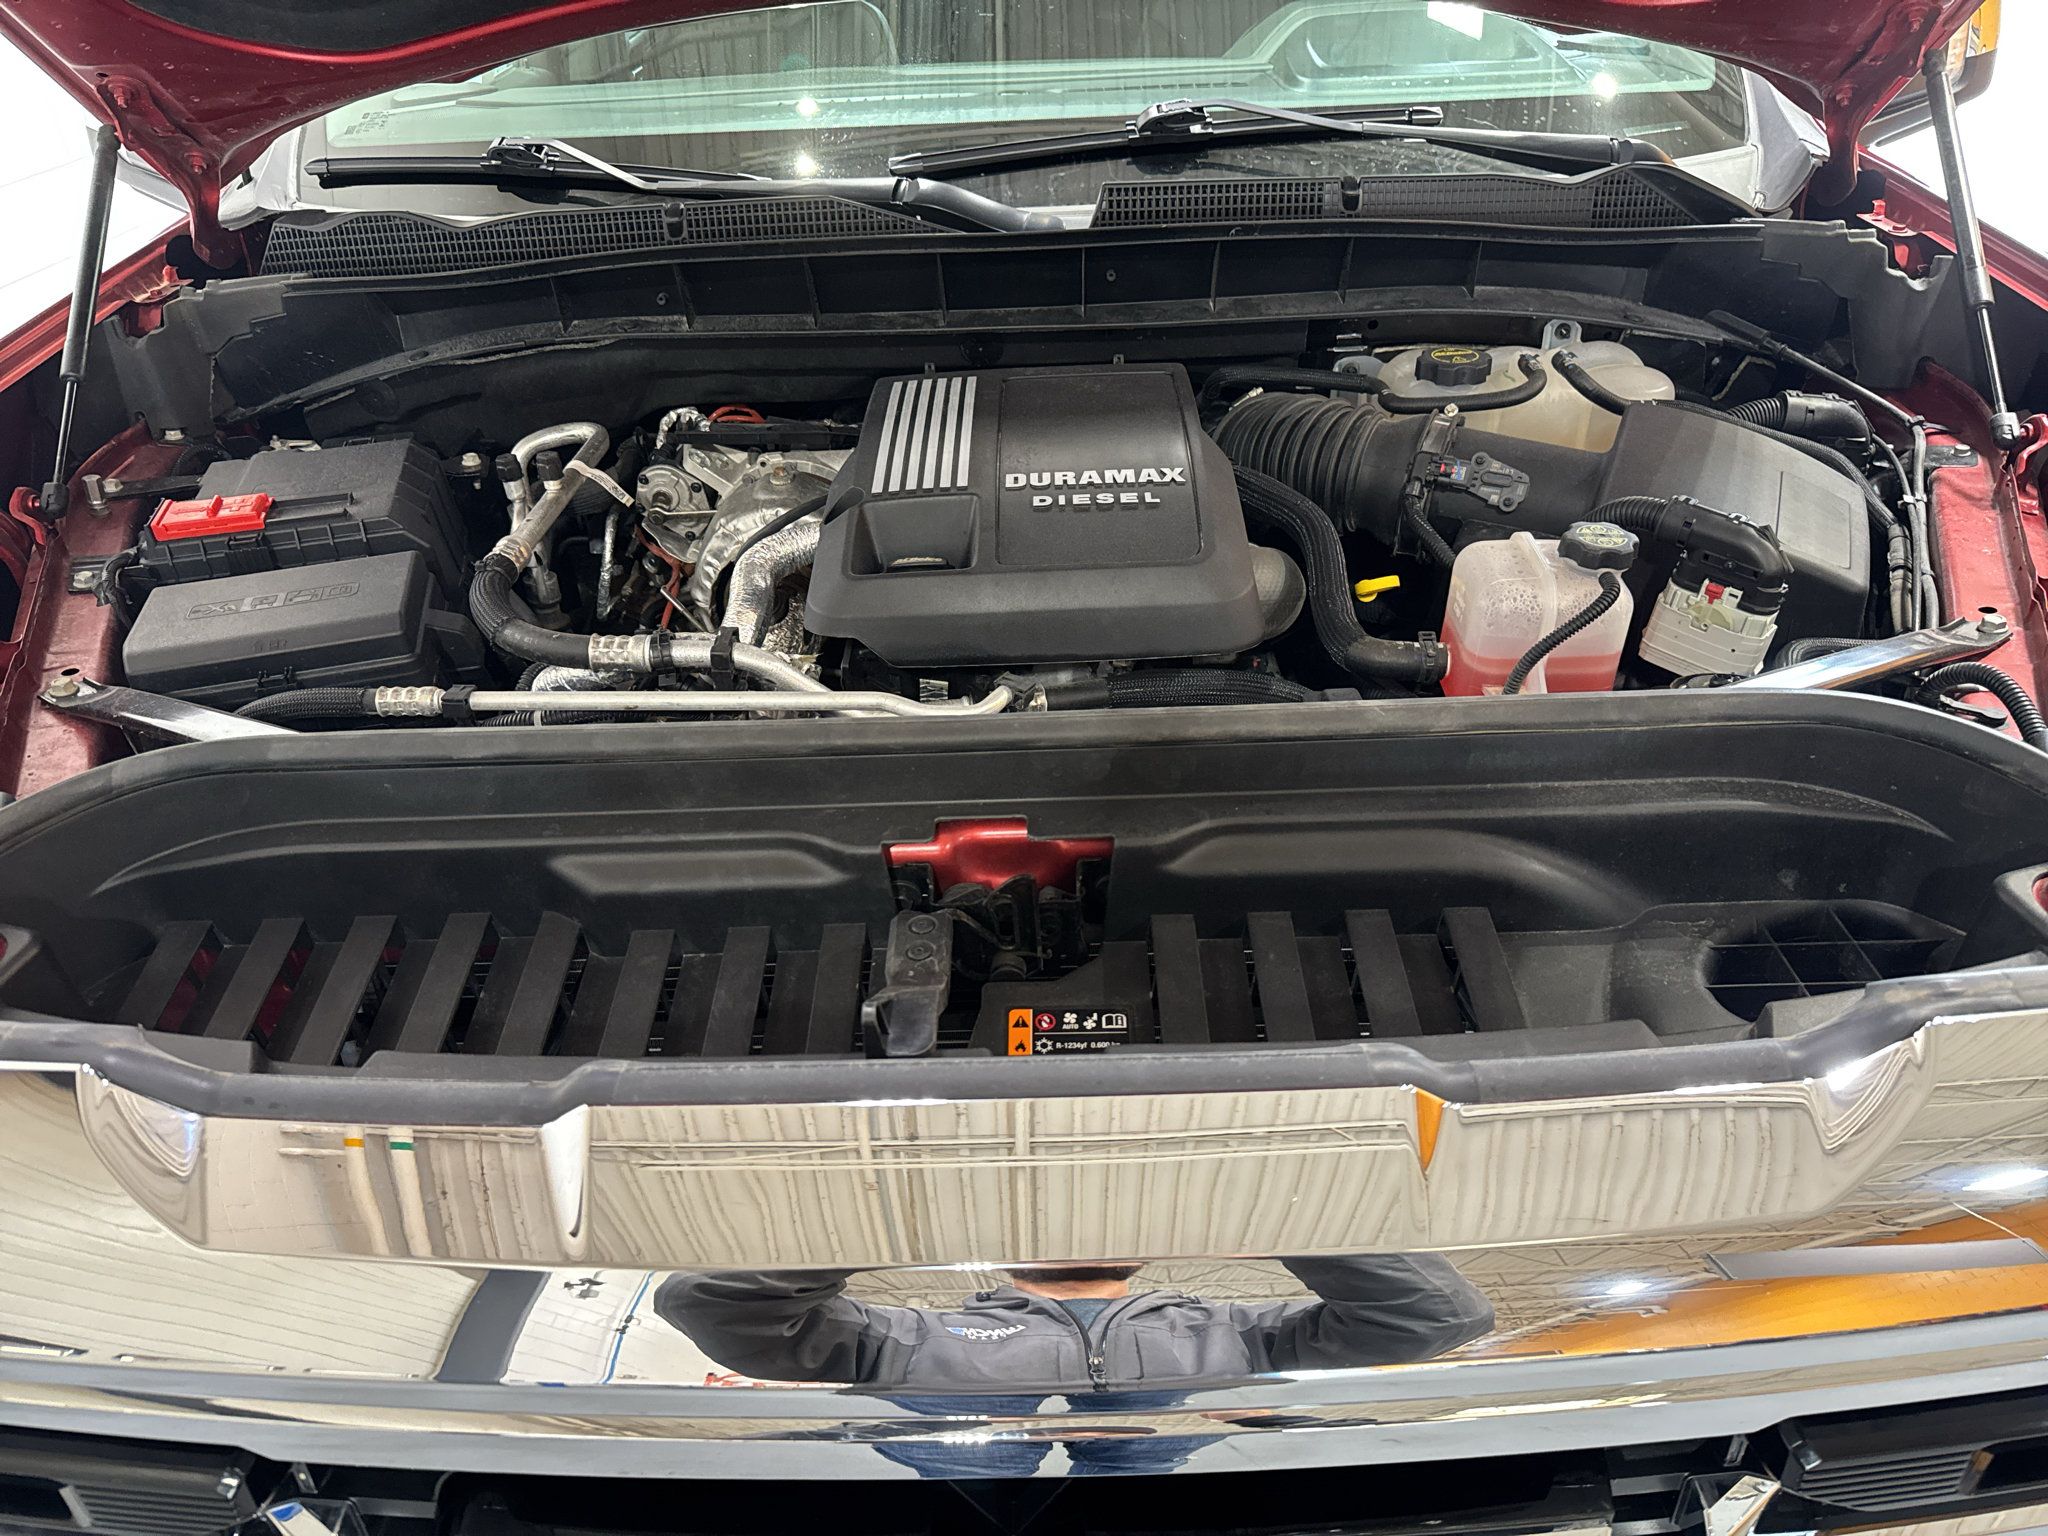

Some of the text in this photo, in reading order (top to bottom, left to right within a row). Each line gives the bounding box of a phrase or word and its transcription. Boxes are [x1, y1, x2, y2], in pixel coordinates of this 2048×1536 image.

[1005, 467, 1186, 488] DURAMAX
[1032, 491, 1161, 507] DIESEL
[1056, 1042, 1087, 1050] R-1234yf
